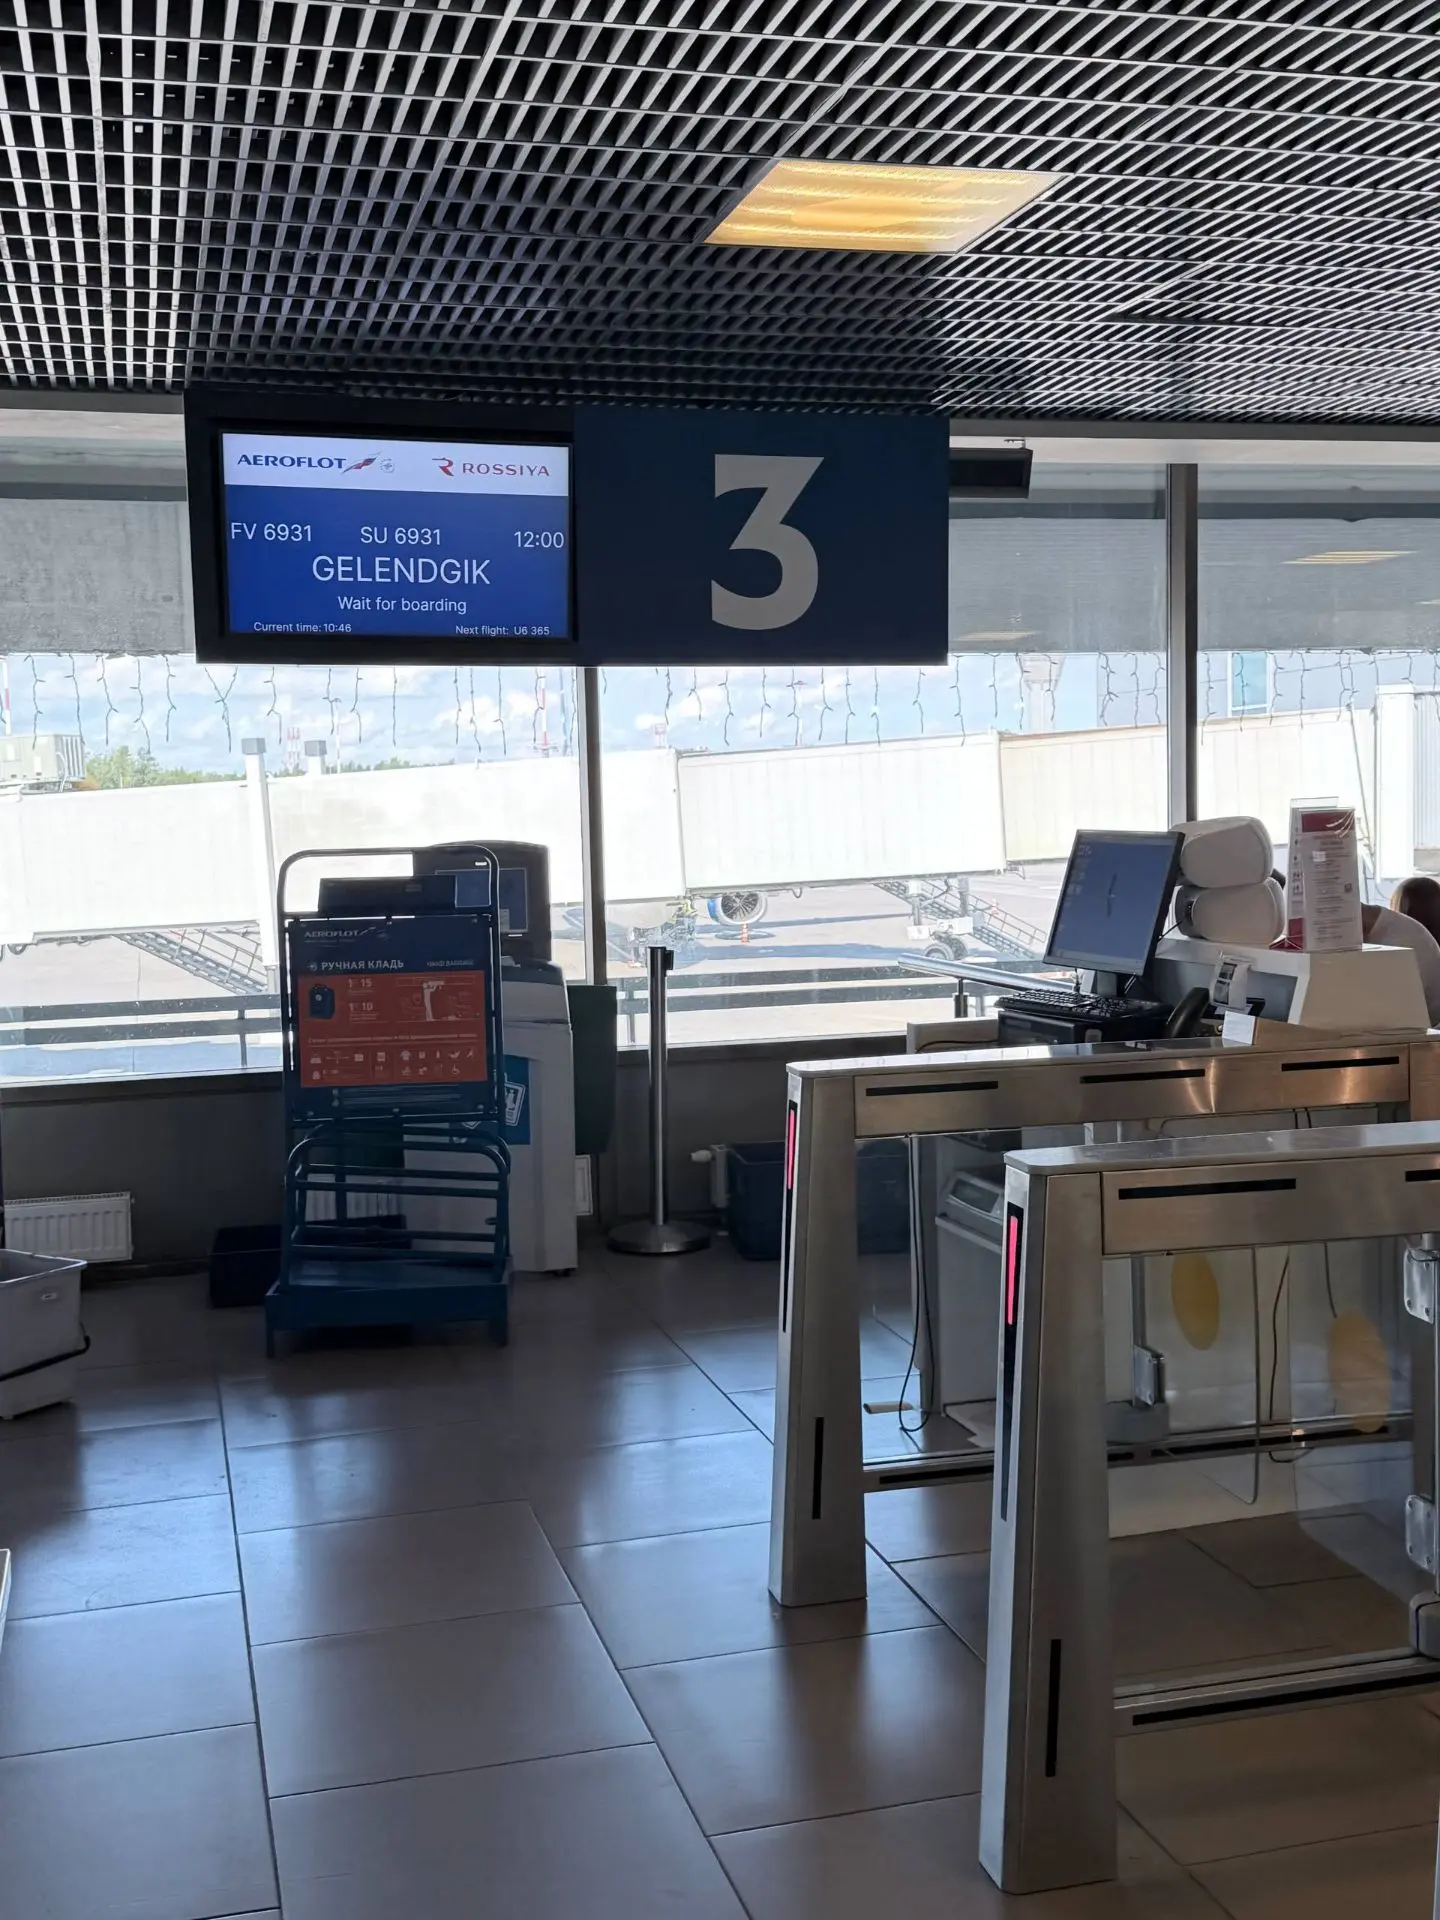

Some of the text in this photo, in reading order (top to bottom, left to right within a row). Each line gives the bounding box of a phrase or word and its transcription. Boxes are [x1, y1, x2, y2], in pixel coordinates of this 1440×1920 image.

[237, 454, 346, 469] AEROFLOT
[462, 462, 550, 476] ROSSIYA
[231, 522, 312, 542] FV 6931
[360, 526, 441, 545] SU 6931
[514, 531, 565, 549] 12:00
[711, 453, 825, 631] 3
[312, 555, 491, 585] GELENDGIK
[337, 595, 467, 615] Wait for boarding
[253, 621, 352, 633] Current time: 10:46
[455, 625, 550, 637] Next flight: U6 365
[321, 959, 405, 971] РУЧНАЯ КЛАДЬ
